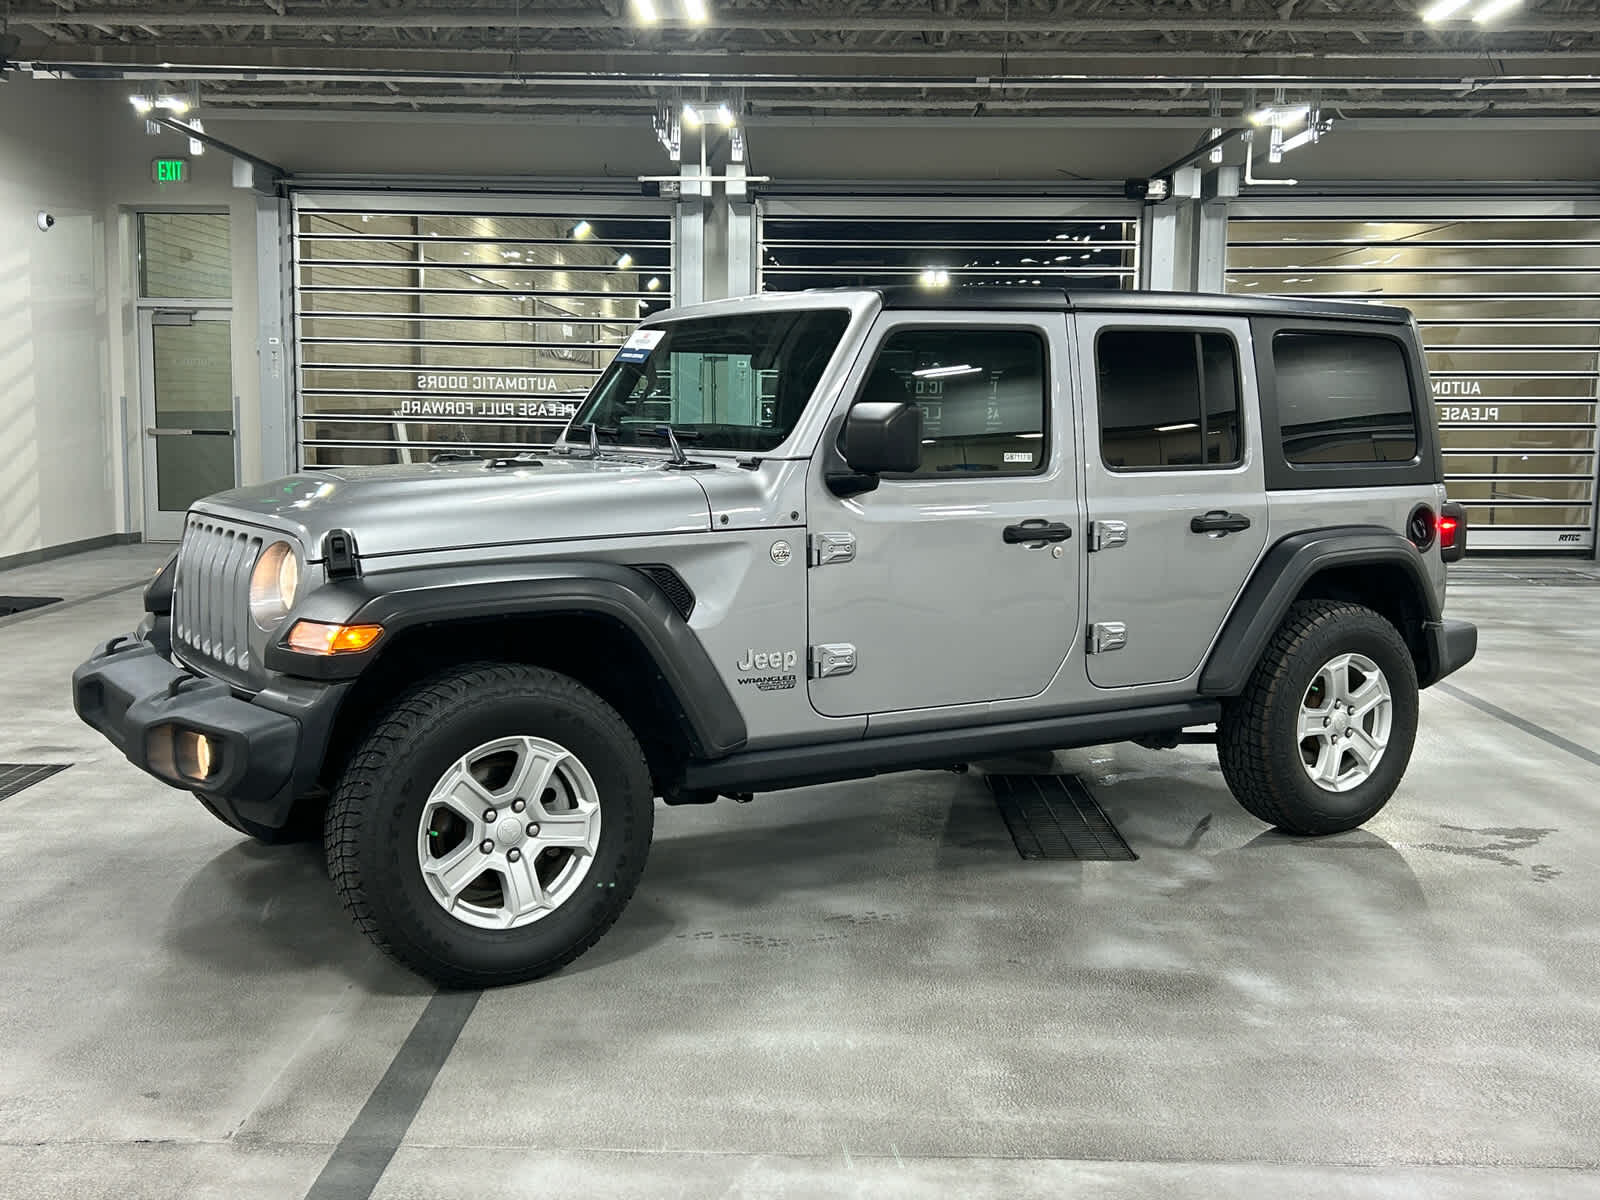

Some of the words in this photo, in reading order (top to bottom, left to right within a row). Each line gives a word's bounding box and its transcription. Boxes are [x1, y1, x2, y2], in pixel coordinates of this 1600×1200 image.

[158, 160, 182, 181] EXIT
[736, 648, 798, 673] Jeep
[737, 674, 797, 685] WRANGLER
